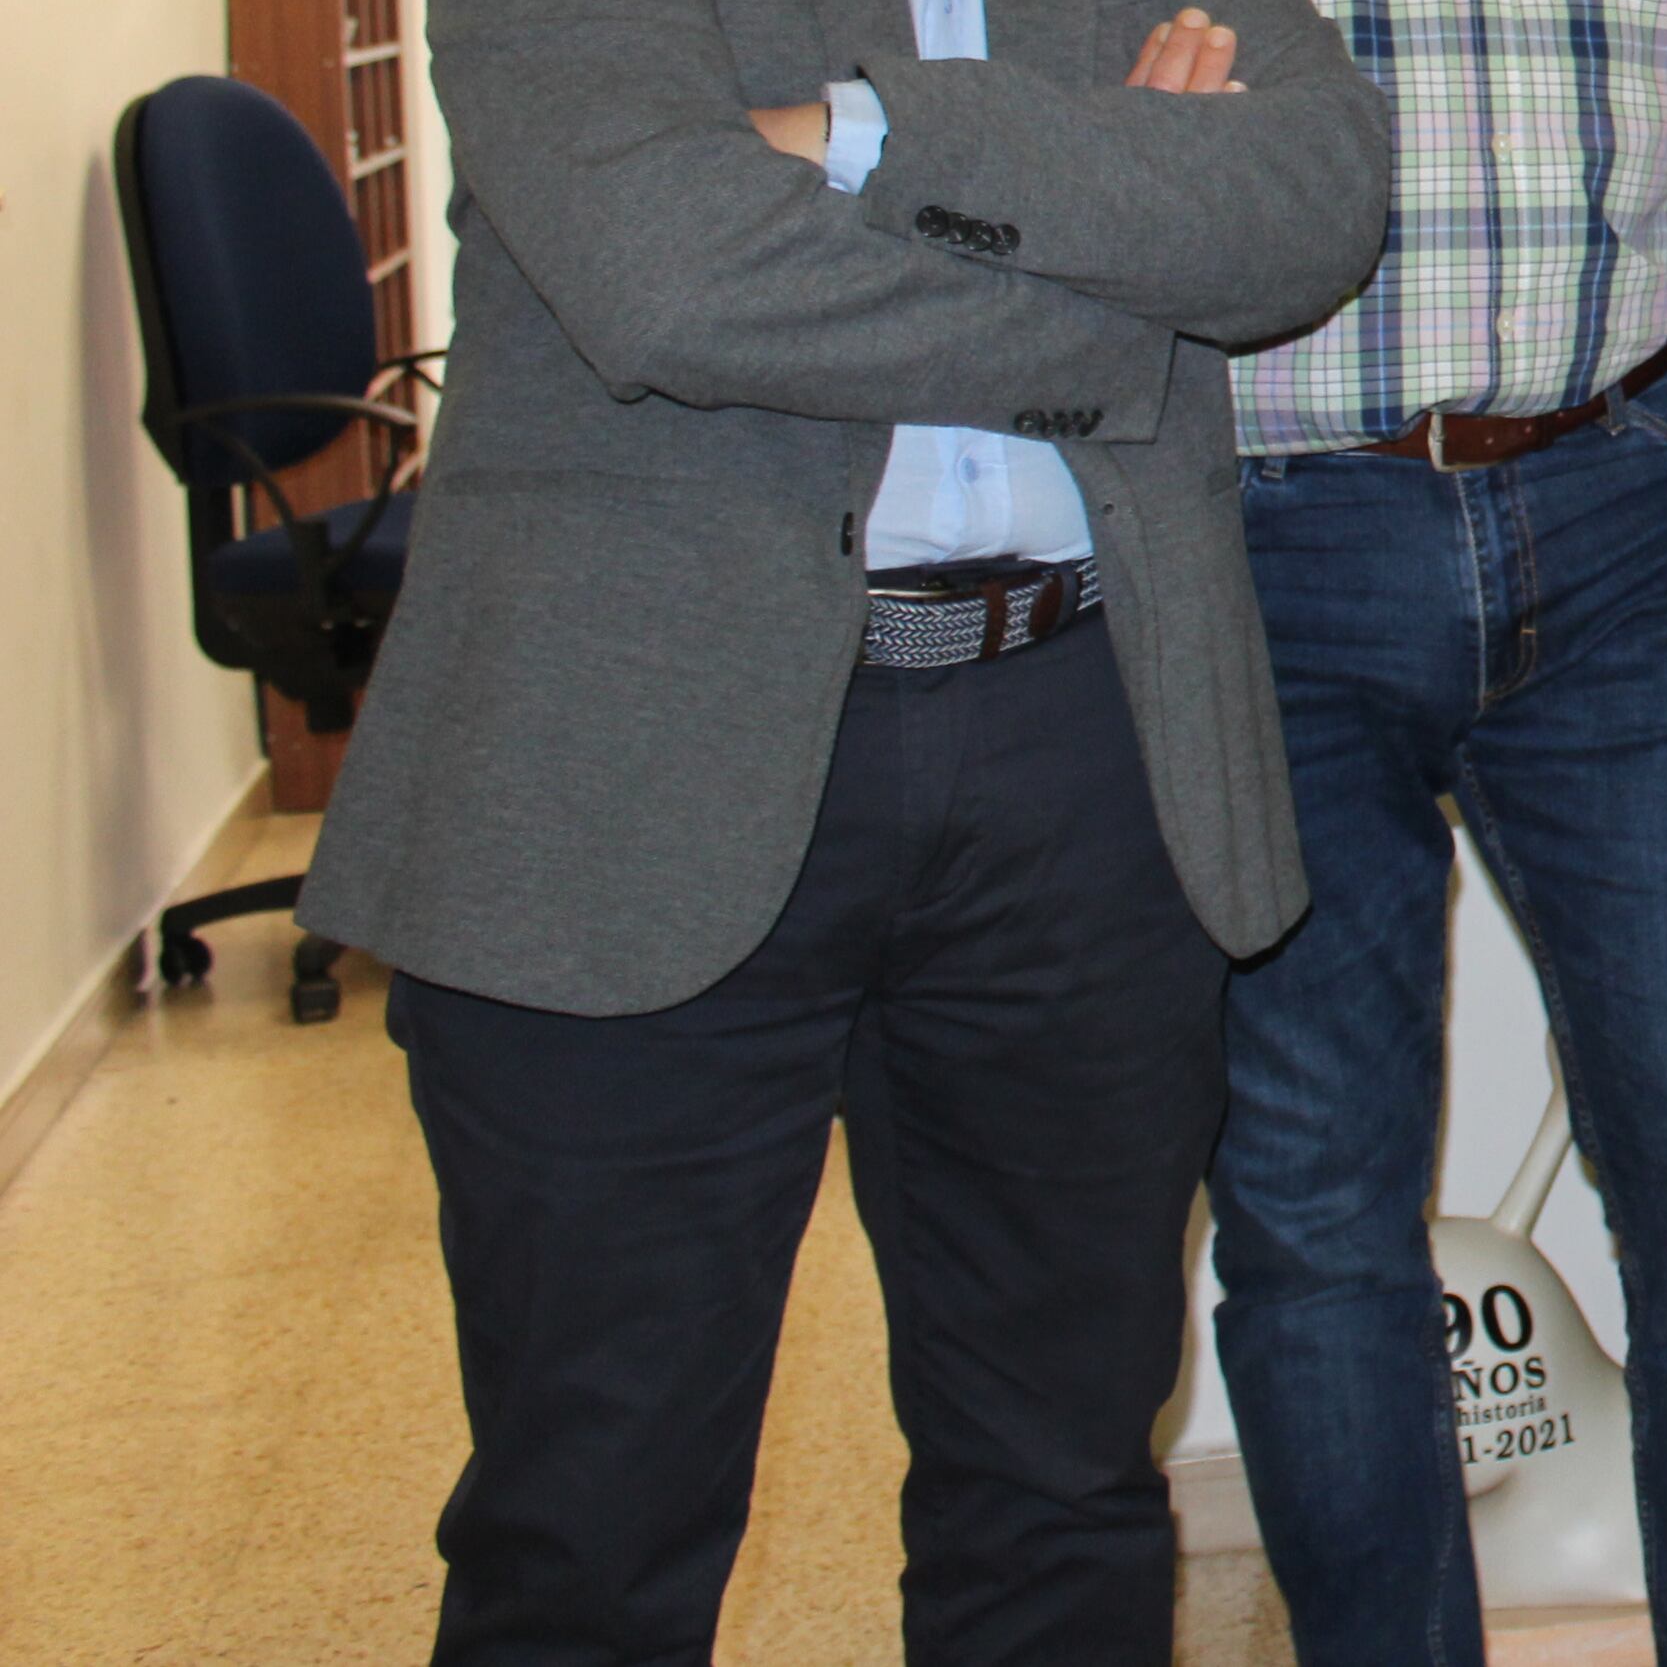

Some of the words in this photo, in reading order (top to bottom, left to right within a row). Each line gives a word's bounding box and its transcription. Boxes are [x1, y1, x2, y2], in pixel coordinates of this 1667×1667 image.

[1442, 1284, 1534, 1360] 90
[1453, 1356, 1547, 1402] ÑOS
[1457, 1394, 1547, 1428] historia
[1462, 1412, 1576, 1465] 1-2021
